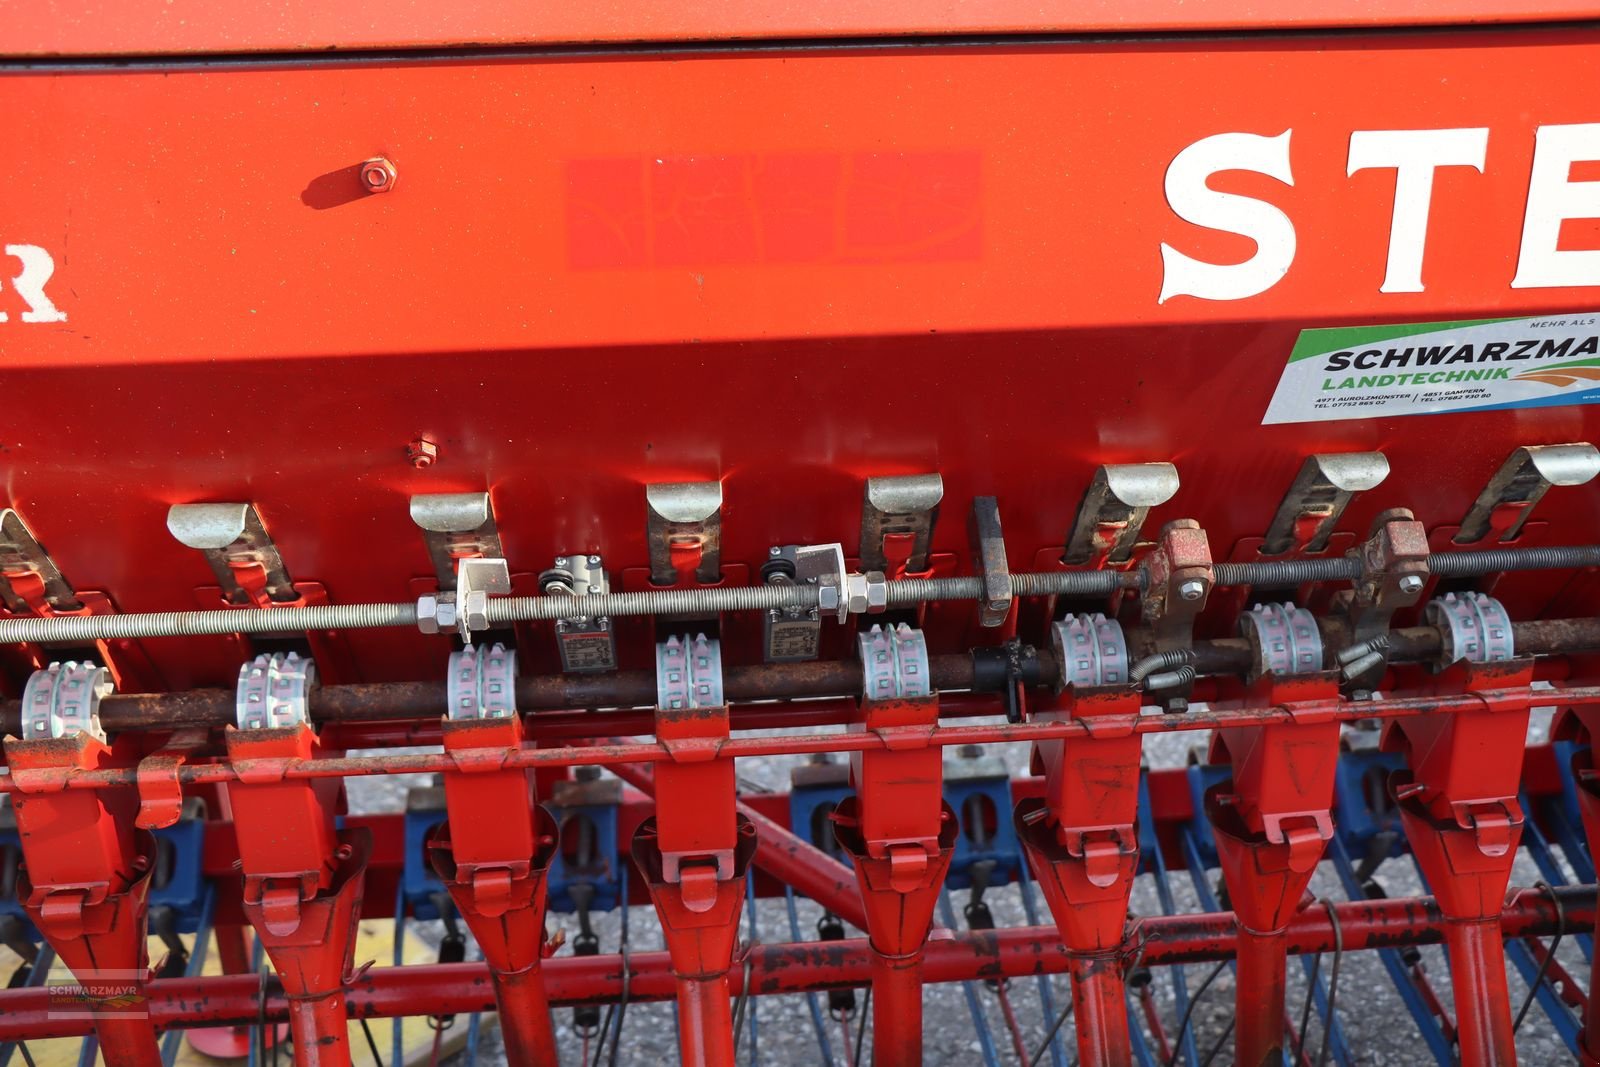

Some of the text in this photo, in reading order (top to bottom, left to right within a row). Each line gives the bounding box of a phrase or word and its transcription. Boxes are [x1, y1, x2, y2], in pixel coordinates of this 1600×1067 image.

[1530, 318, 1596, 329] MEHR ALS
[1324, 336, 1599, 372] SCHWARZMA
[1322, 367, 1514, 390] LANDTECHNIK
[1444, 388, 1486, 396] GAMPERN
